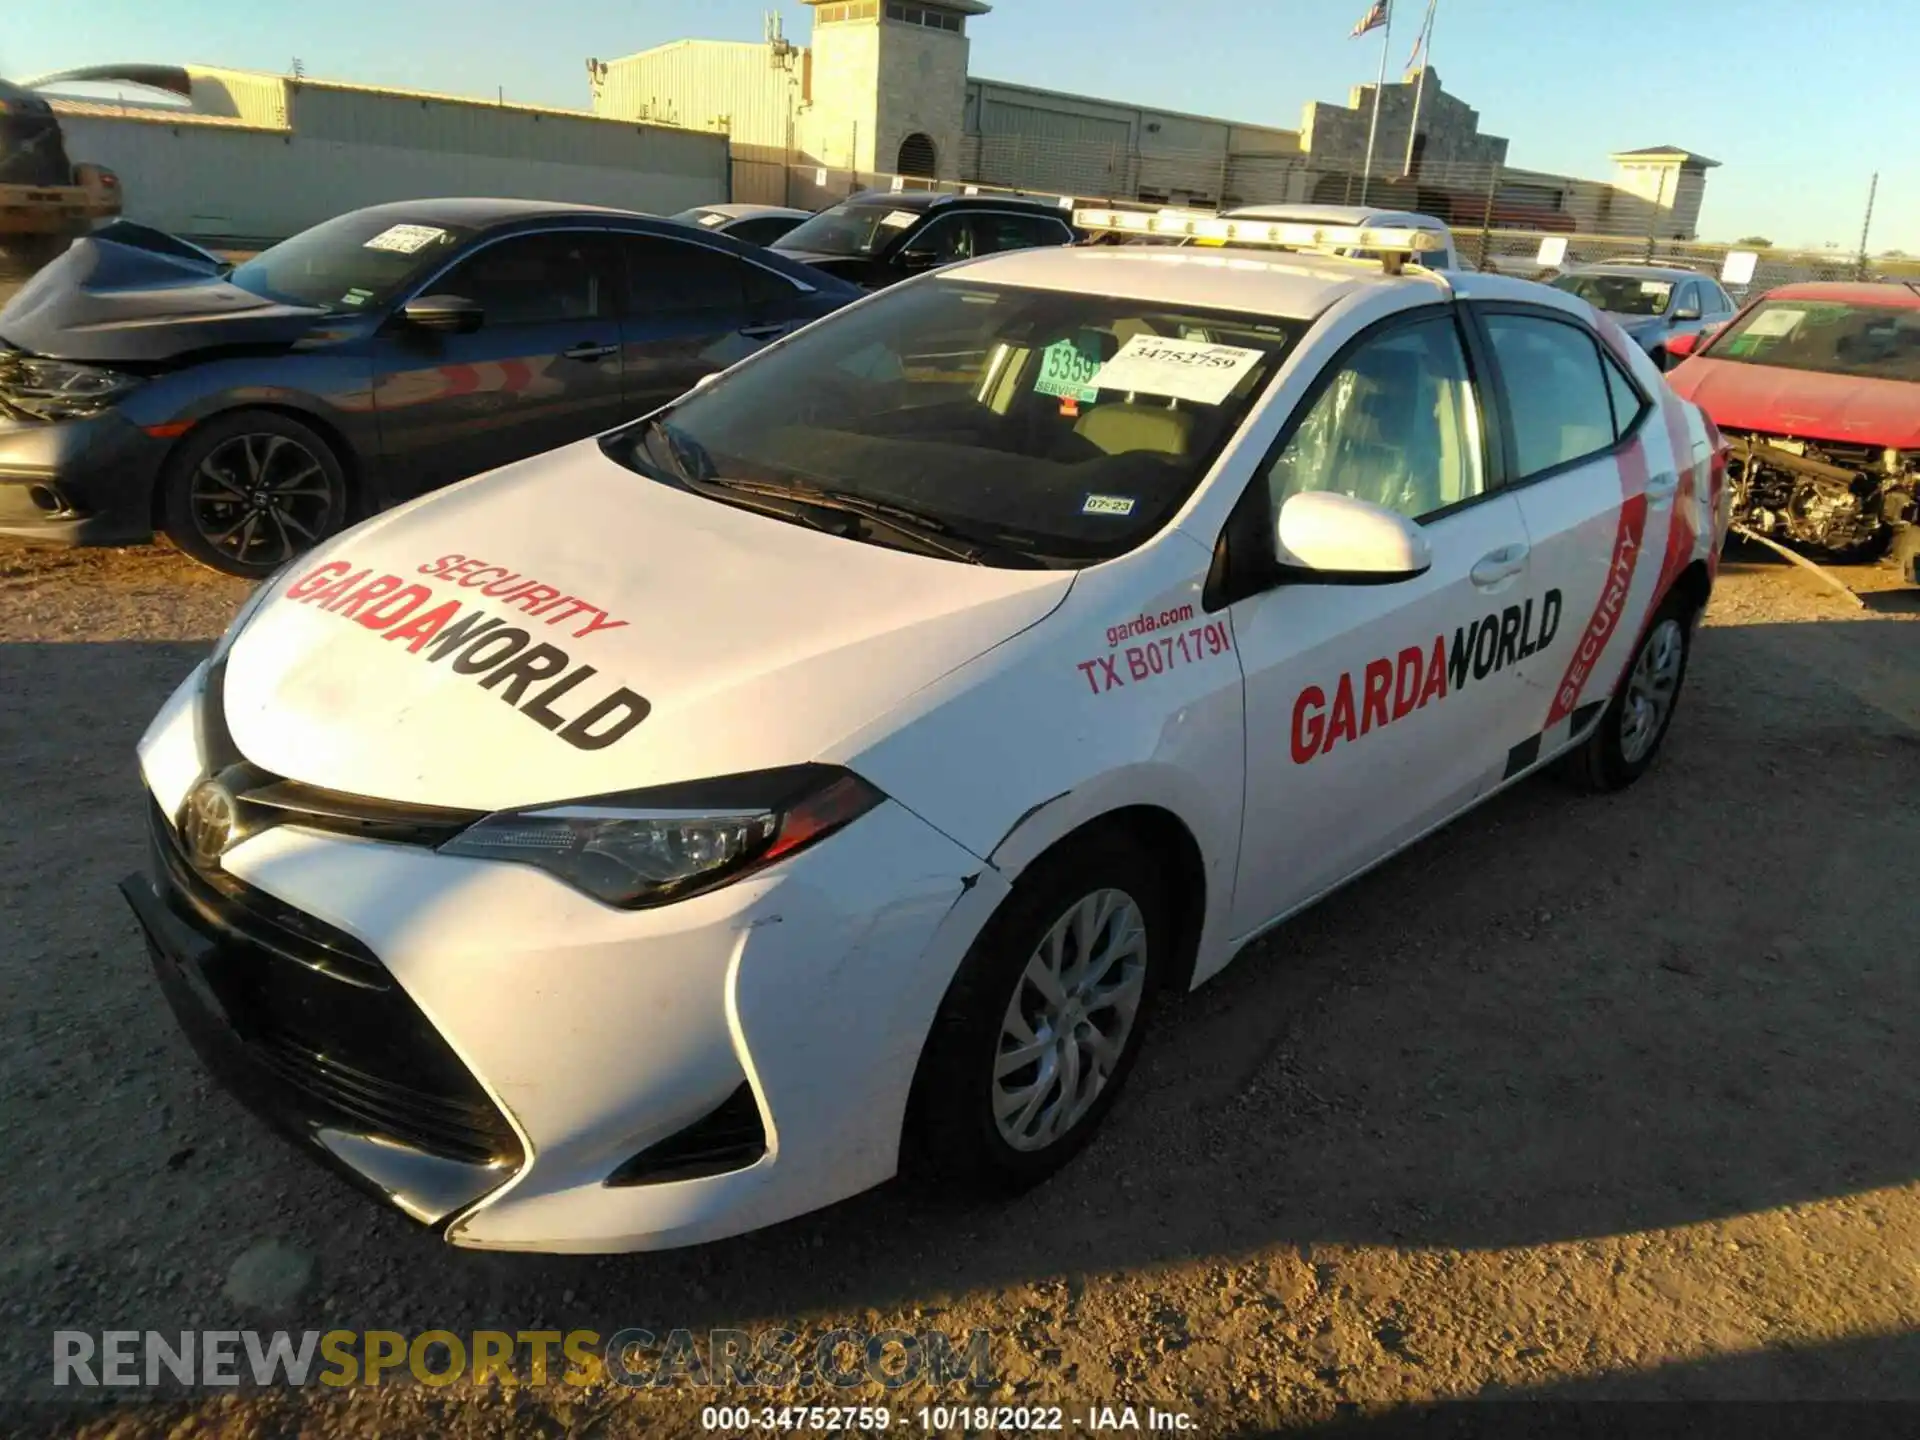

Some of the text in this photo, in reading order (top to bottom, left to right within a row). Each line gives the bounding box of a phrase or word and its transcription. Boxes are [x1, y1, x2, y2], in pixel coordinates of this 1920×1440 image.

[1048, 347, 1094, 384] 5359
[1130, 346, 1237, 369] 34752759
[417, 554, 630, 638] SECURITY
[1106, 603, 1194, 647] garda.com
[1559, 525, 1637, 712] SECURITY
[285, 561, 652, 751] GARDAWORLD
[1077, 654, 1124, 695] TX
[1290, 587, 1563, 765] GARDAWORLD
